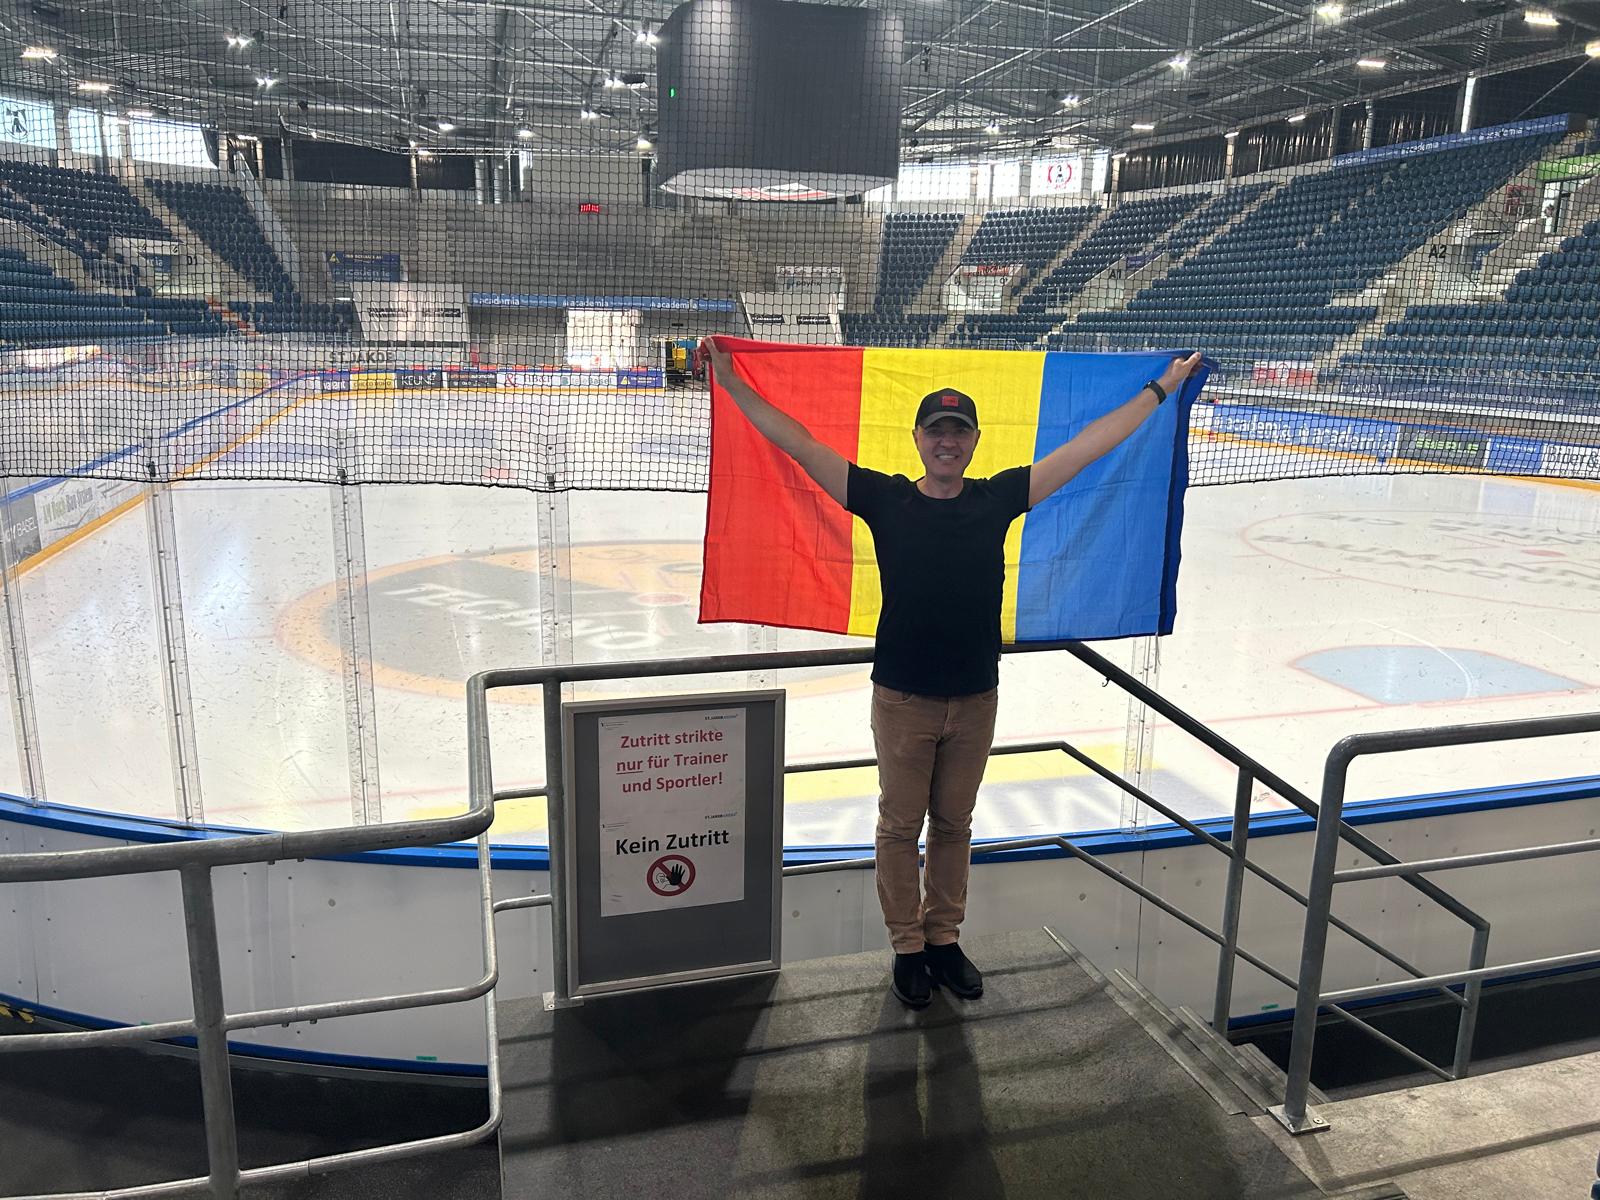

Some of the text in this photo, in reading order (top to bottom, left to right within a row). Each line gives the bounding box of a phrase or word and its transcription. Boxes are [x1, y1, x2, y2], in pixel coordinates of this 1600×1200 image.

[187, 255, 198, 266] D1
[1429, 244, 1447, 258] A2
[620, 729, 723, 749] Zutritt strikte
[616, 752, 728, 772] nur für Trainer
[622, 772, 723, 793] und Sportler!
[616, 830, 729, 855] Kein Zutritt
